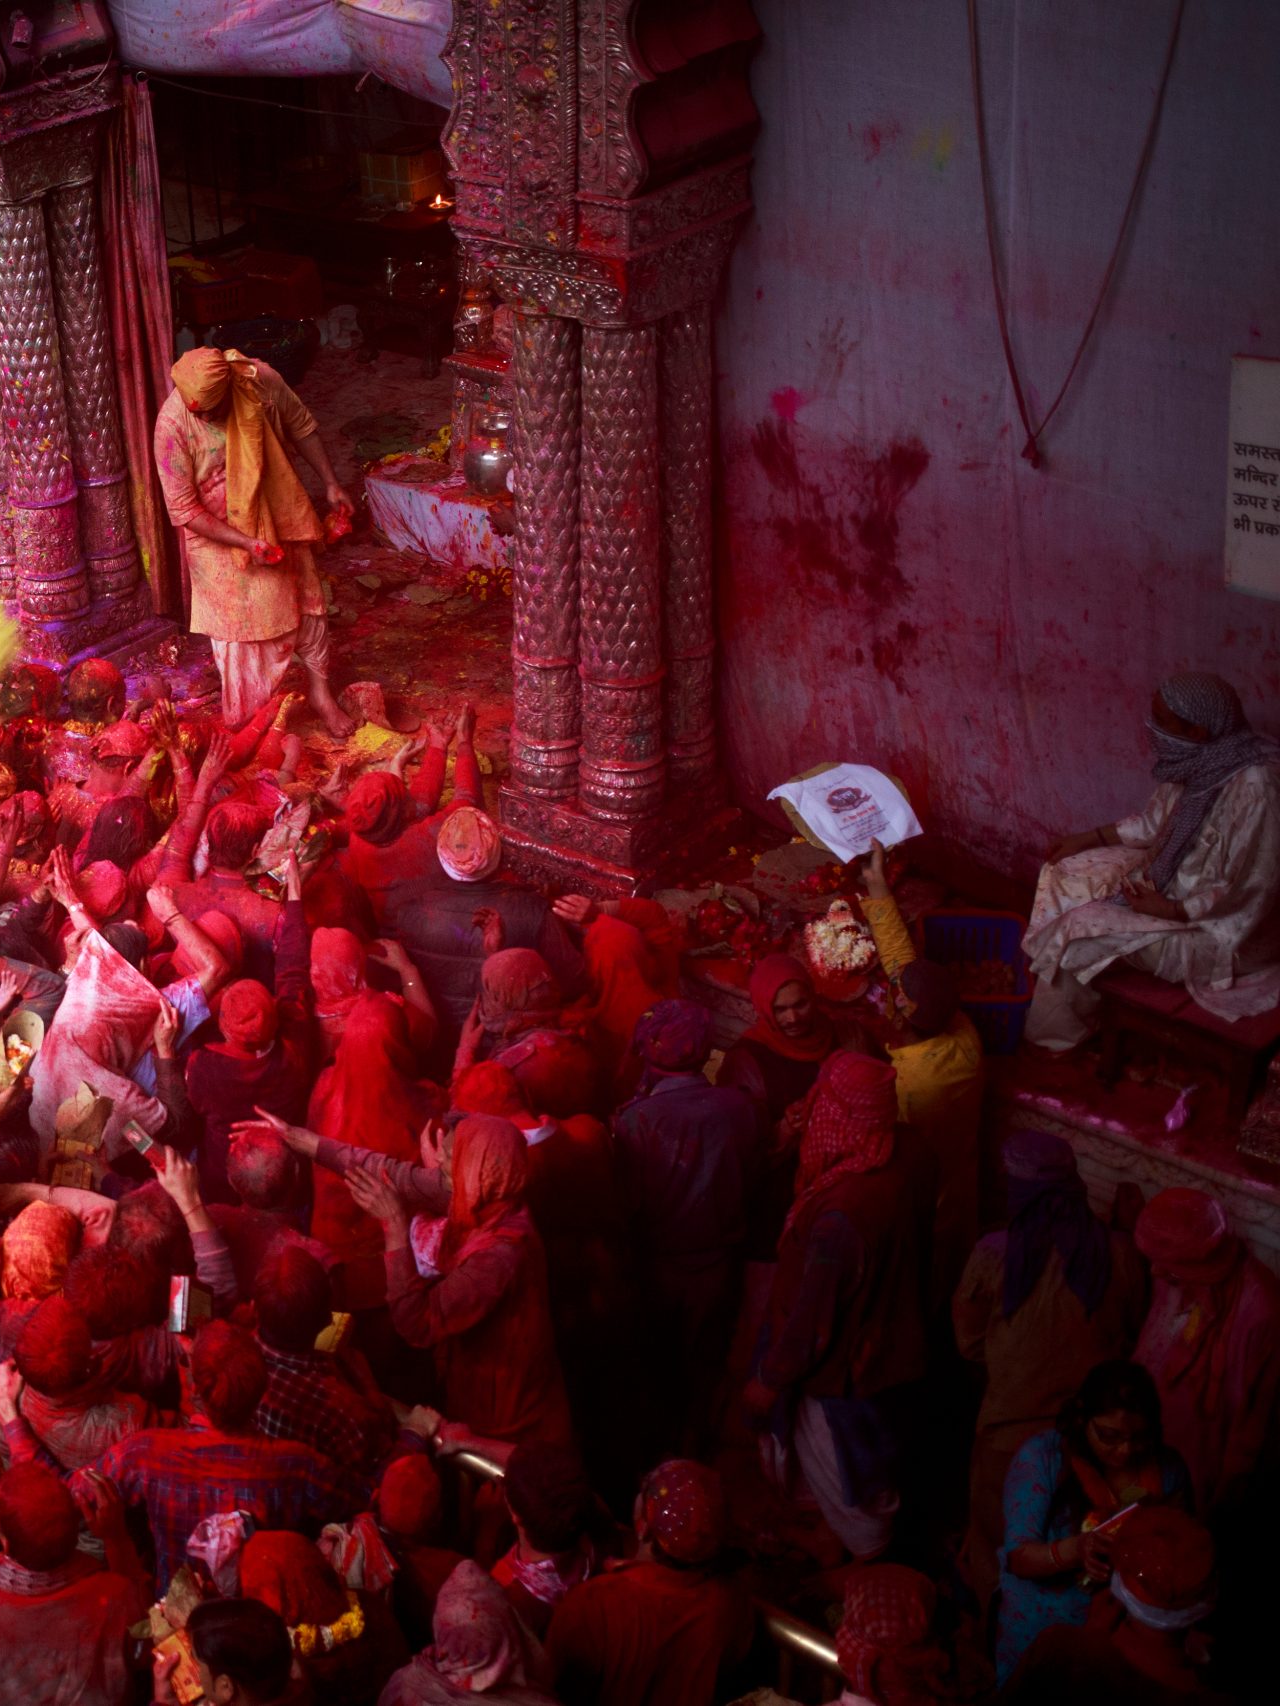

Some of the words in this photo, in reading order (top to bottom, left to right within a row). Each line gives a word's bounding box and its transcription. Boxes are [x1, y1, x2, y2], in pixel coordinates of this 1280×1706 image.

[1233, 465, 1279, 486] मन्दिर
[1232, 493, 1269, 509] ऊपर
[1233, 514, 1251, 532] भी
[1254, 521, 1280, 536] प्रक
